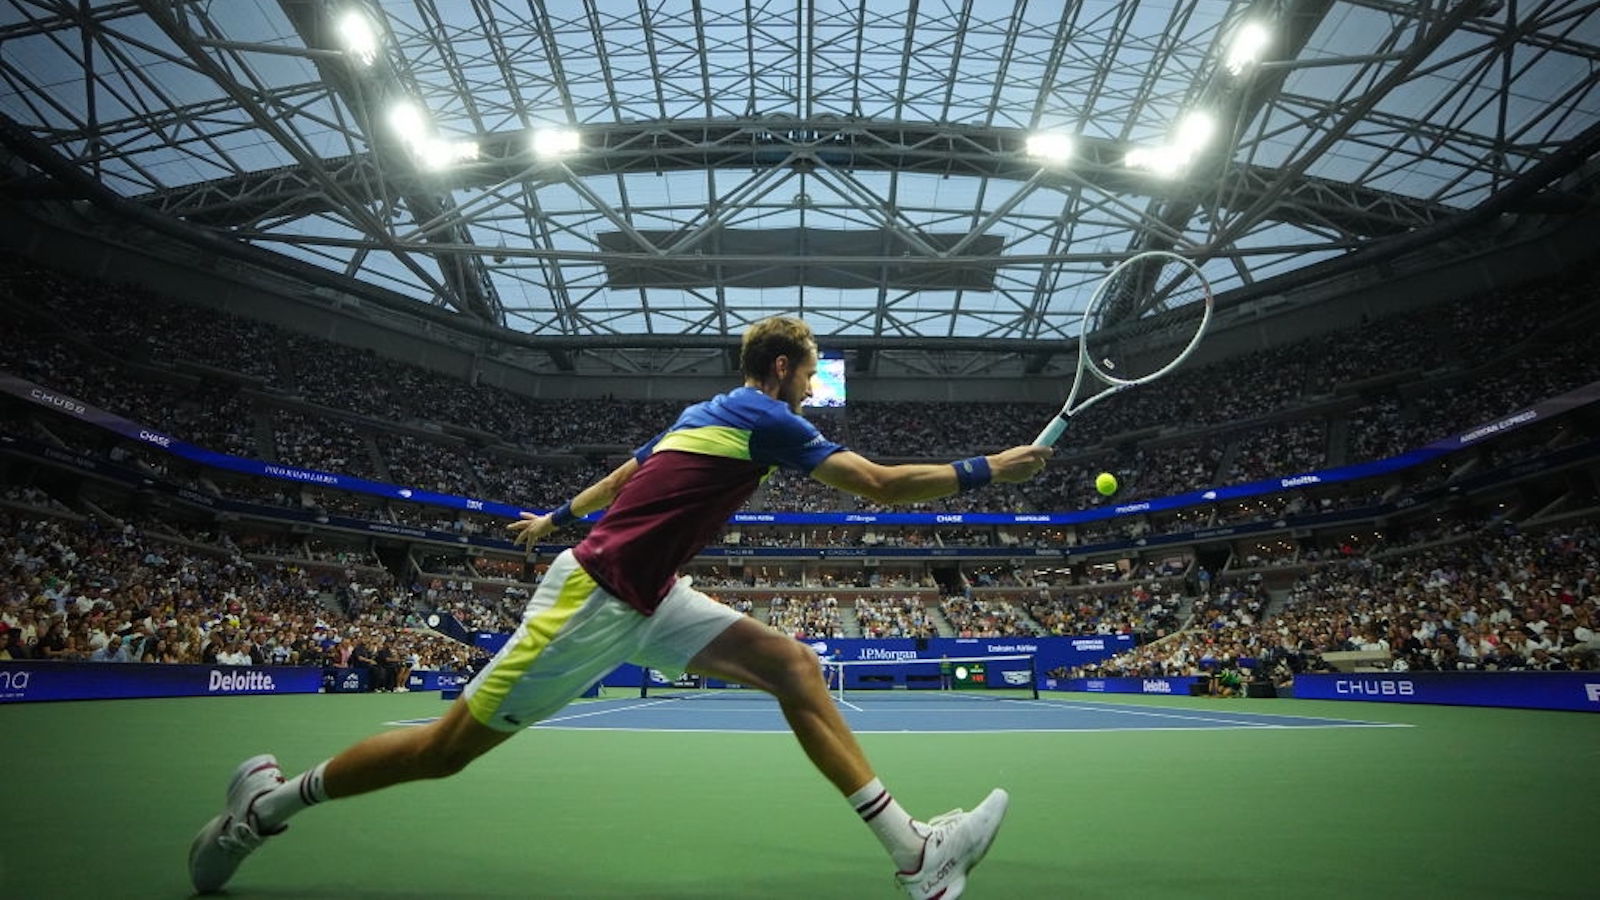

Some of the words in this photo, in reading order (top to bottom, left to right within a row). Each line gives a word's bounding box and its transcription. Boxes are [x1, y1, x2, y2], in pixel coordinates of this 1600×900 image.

[140, 430, 171, 448] CHASE
[936, 514, 963, 522] CHASE
[208, 670, 276, 691] Deloitte.
[1336, 680, 1415, 696] CHUBB
